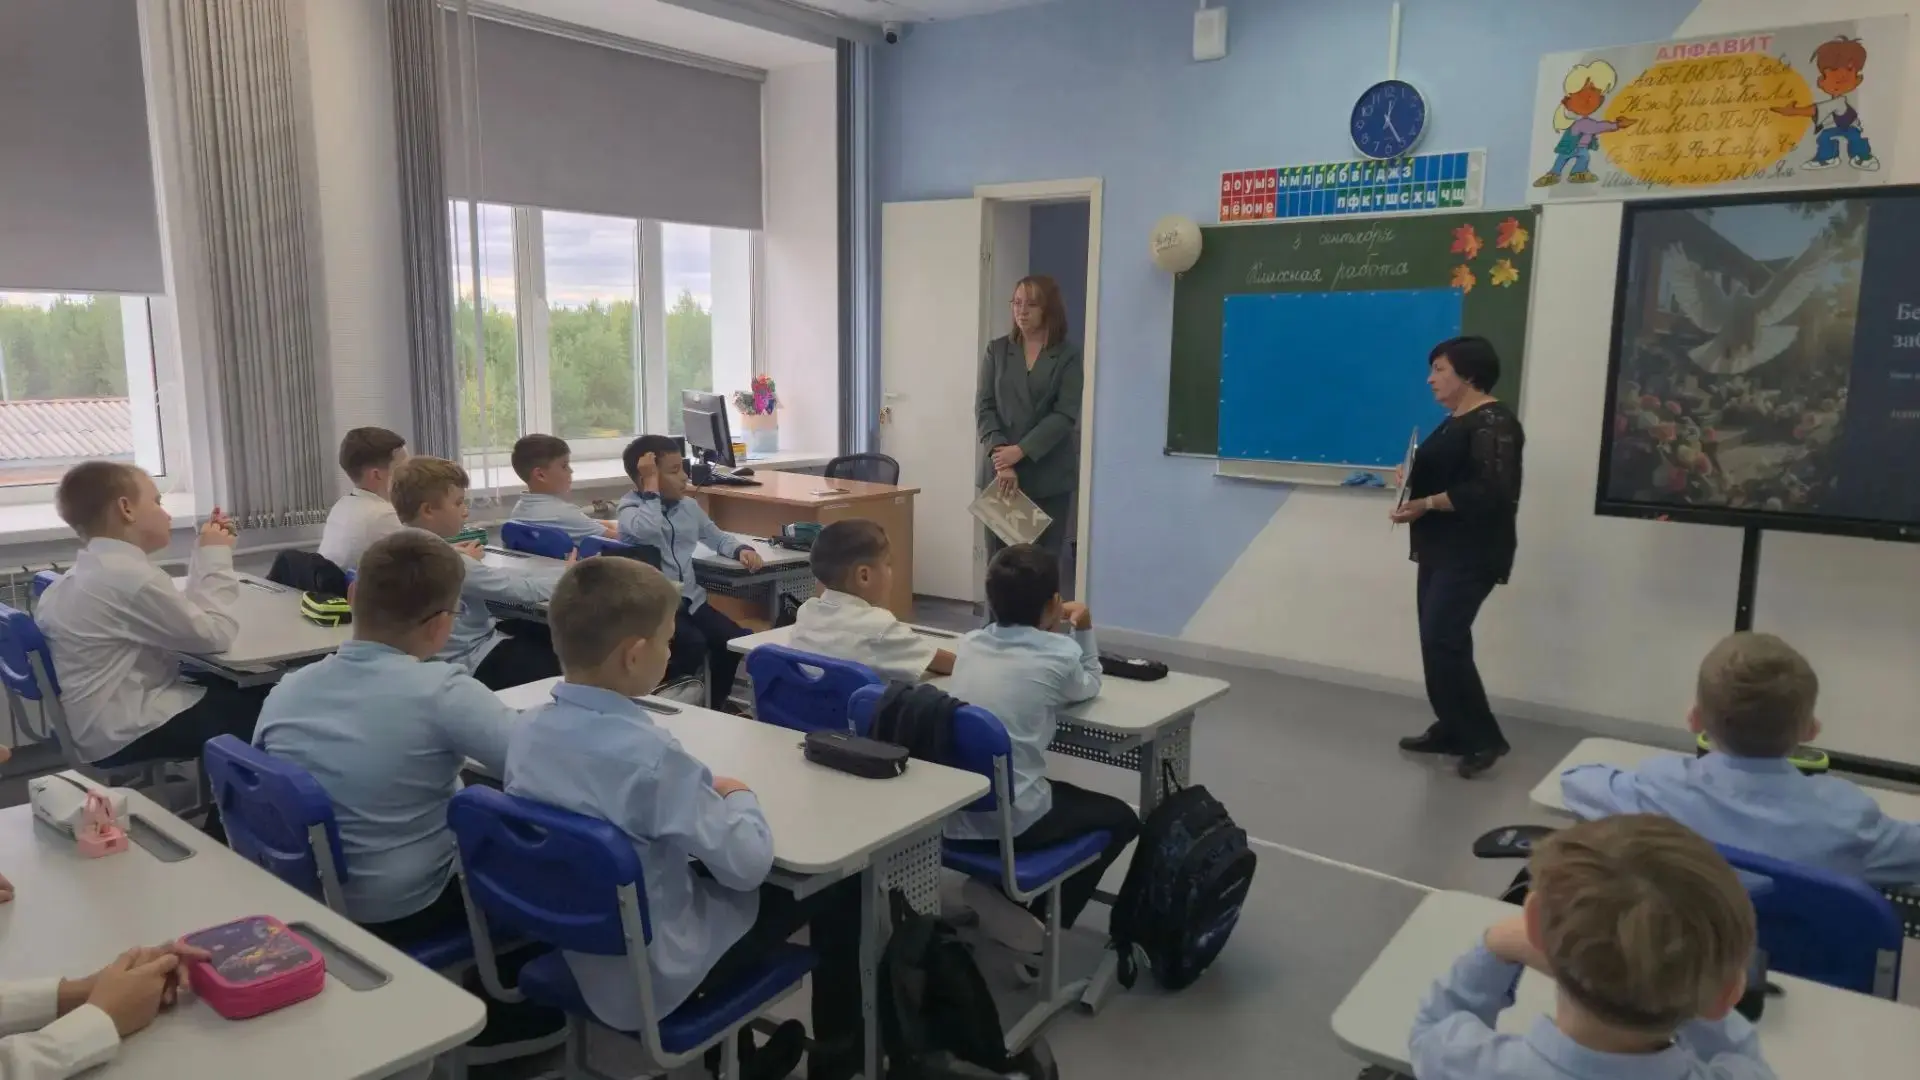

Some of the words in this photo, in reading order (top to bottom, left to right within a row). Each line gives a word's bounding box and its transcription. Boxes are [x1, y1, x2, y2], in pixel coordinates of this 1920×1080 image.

[1656, 35, 1774, 60] АЛФАВИТ
[1245, 258, 1324, 285] Классная
[1330, 252, 1410, 292] работа
